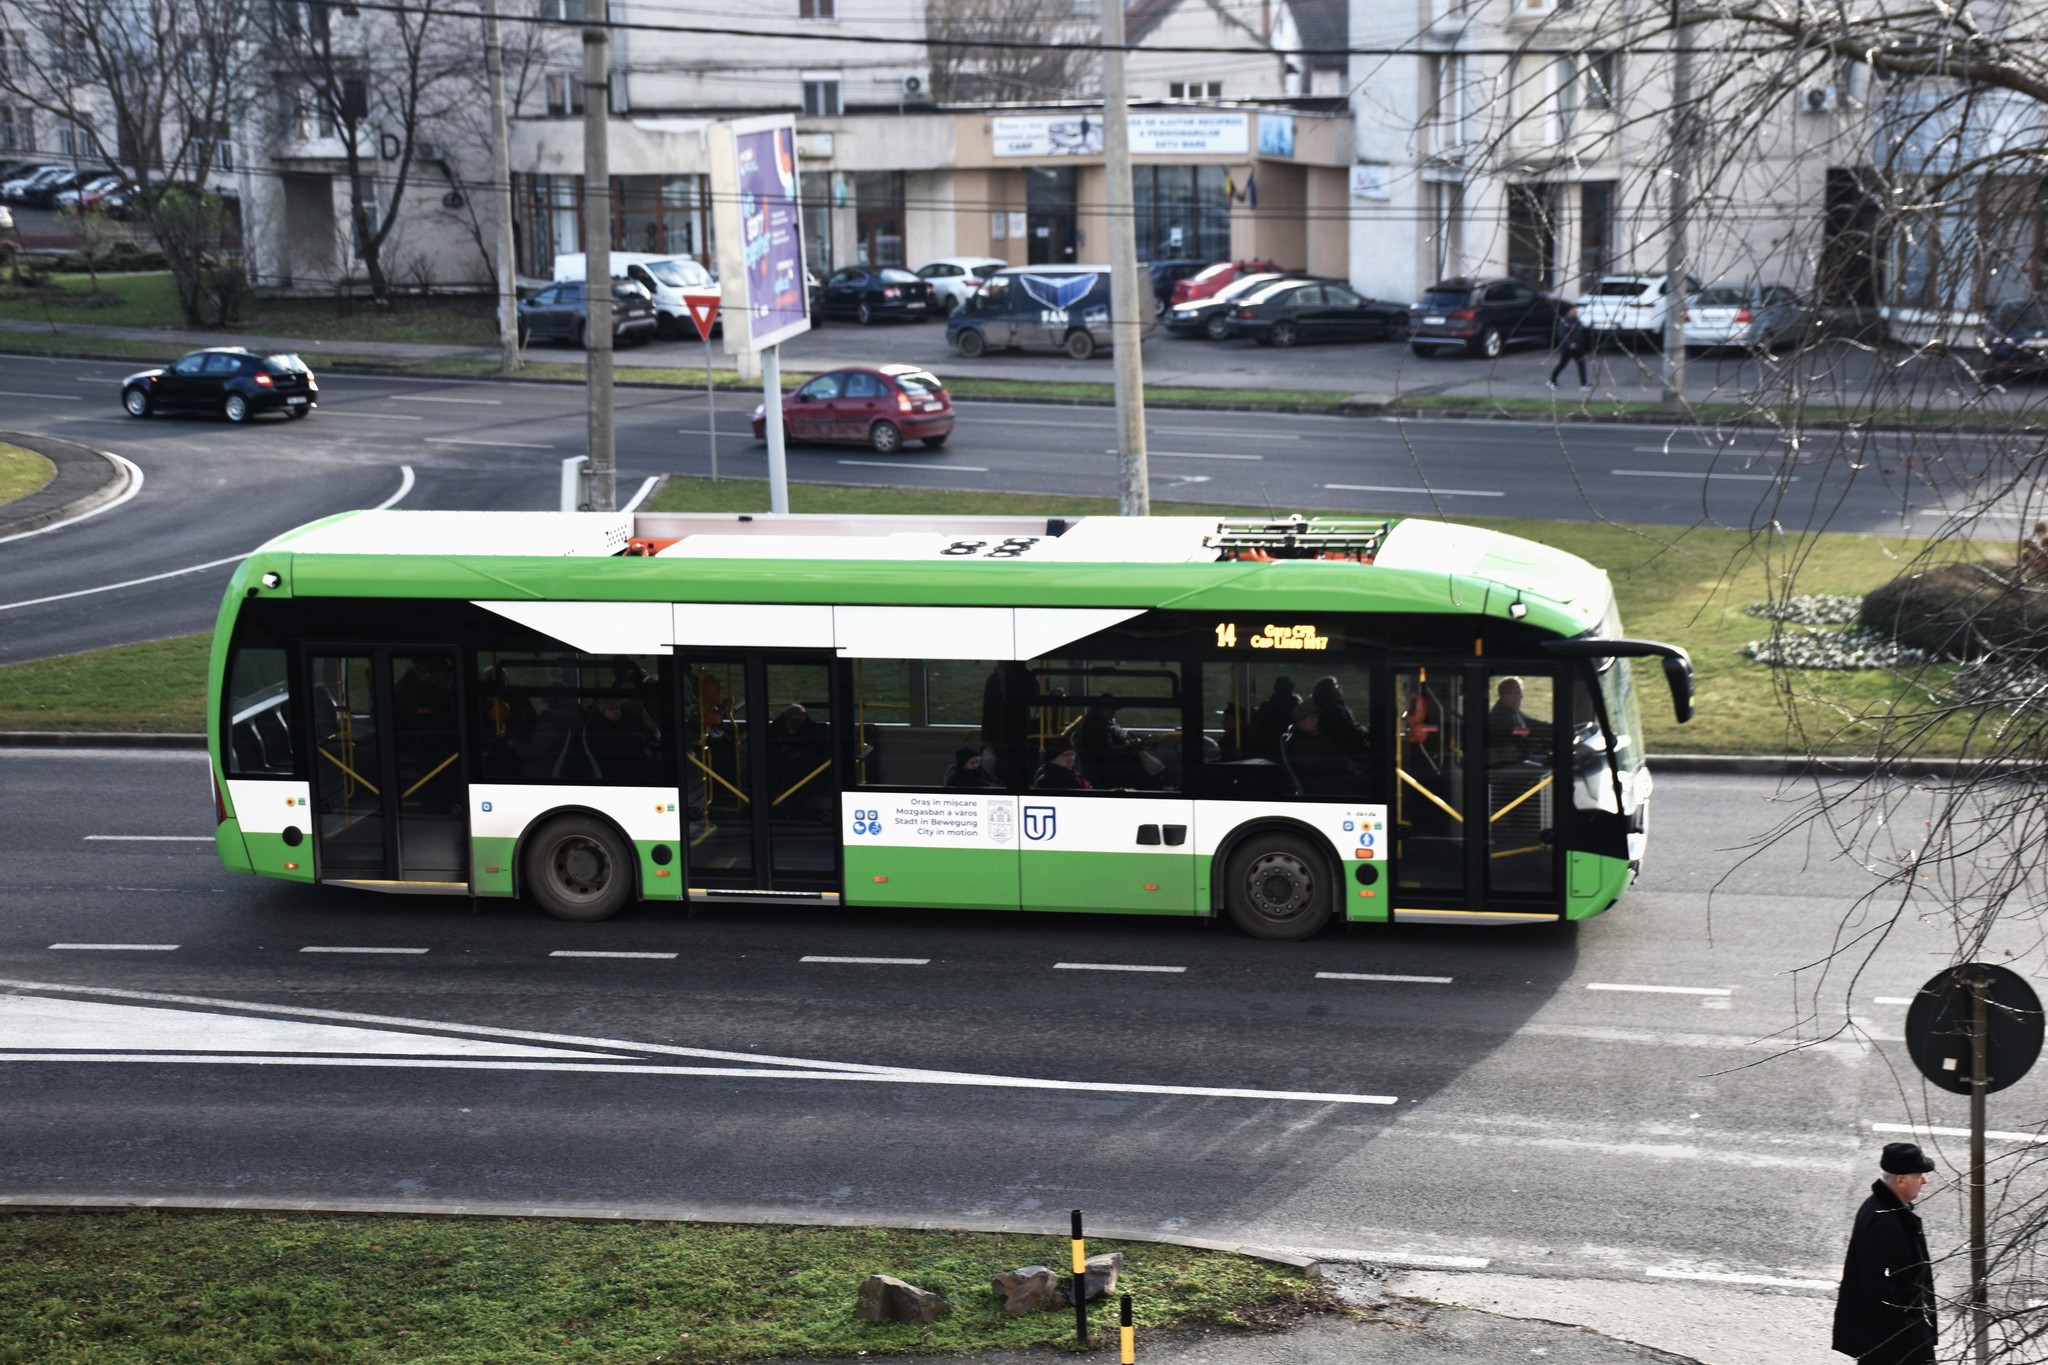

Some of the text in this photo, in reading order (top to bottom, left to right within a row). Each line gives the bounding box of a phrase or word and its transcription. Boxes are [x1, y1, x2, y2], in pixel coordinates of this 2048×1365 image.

[1215, 623, 1237, 648] 14
[895, 817, 918, 825] Stadt
[931, 818, 978, 828] Bewegung
[917, 828, 934, 836] City
